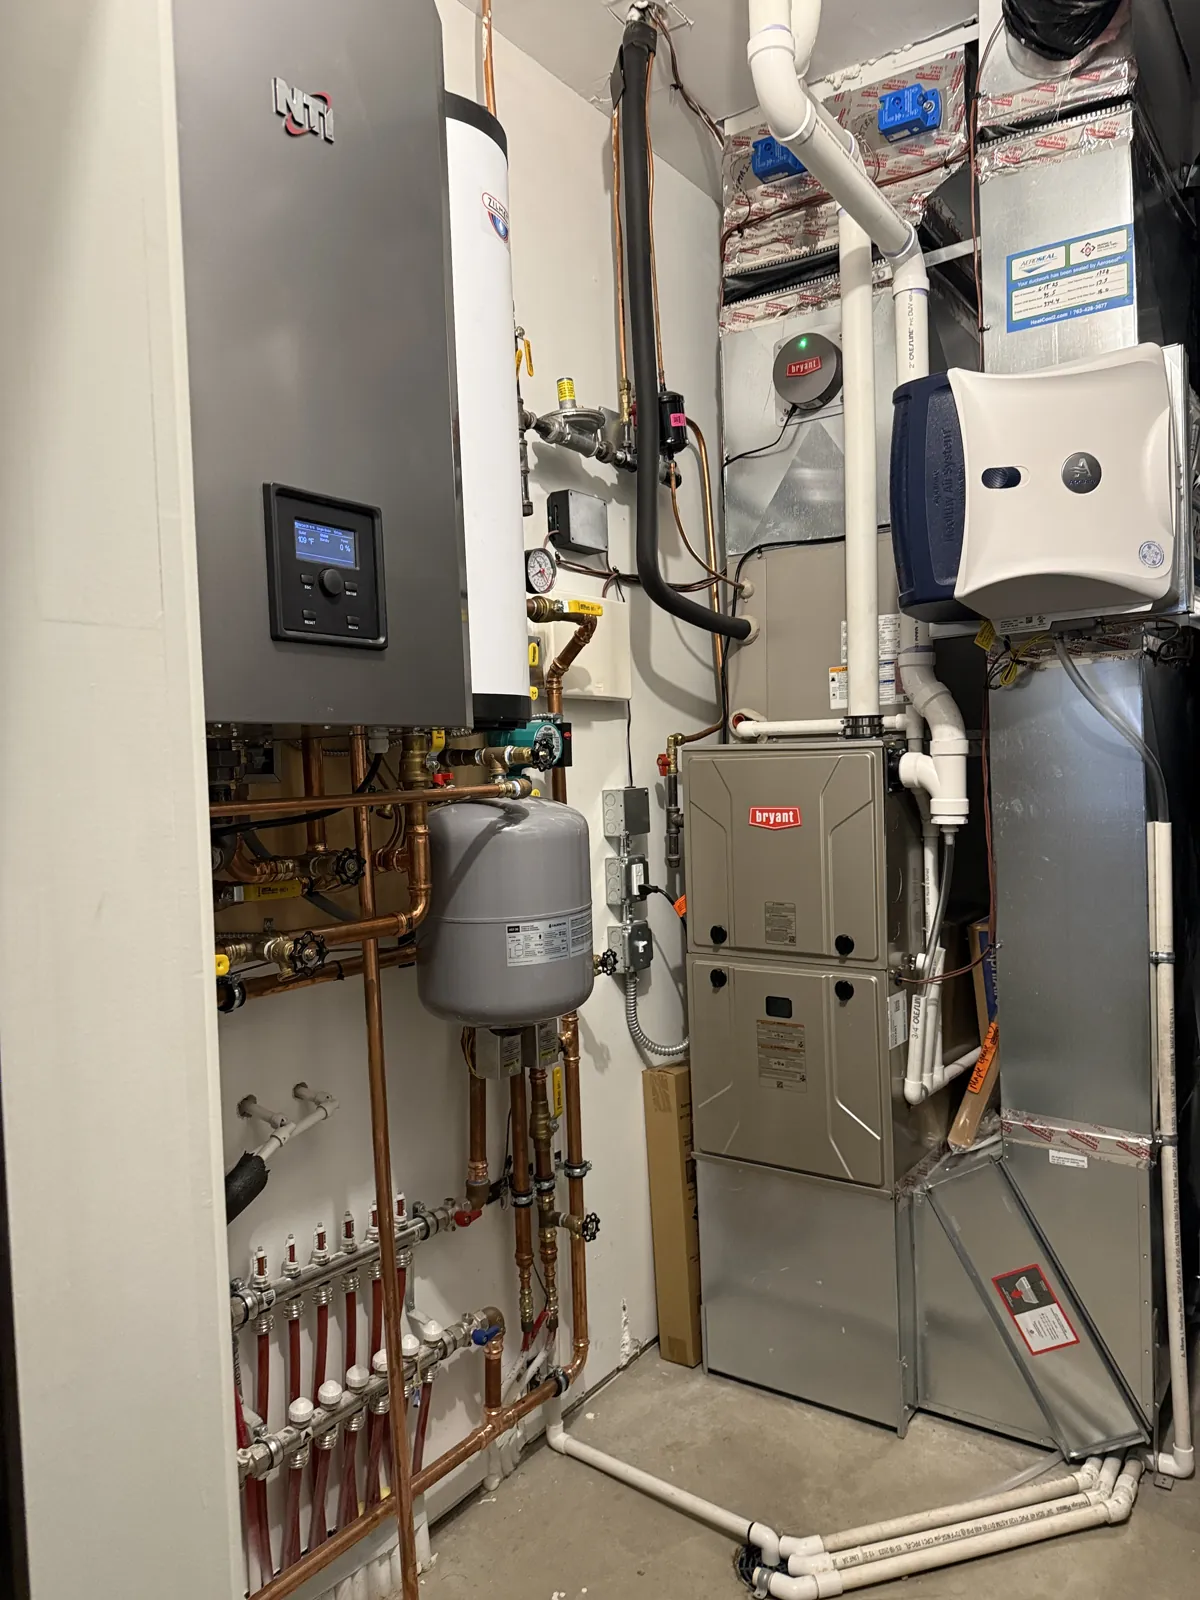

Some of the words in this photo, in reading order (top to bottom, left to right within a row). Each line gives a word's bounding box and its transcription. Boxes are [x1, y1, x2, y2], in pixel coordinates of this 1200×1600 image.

[272, 77, 334, 144] NTI
[791, 360, 817, 374] bryant
[756, 810, 794, 825] bryant
[968, 1066, 985, 1091] Maple
